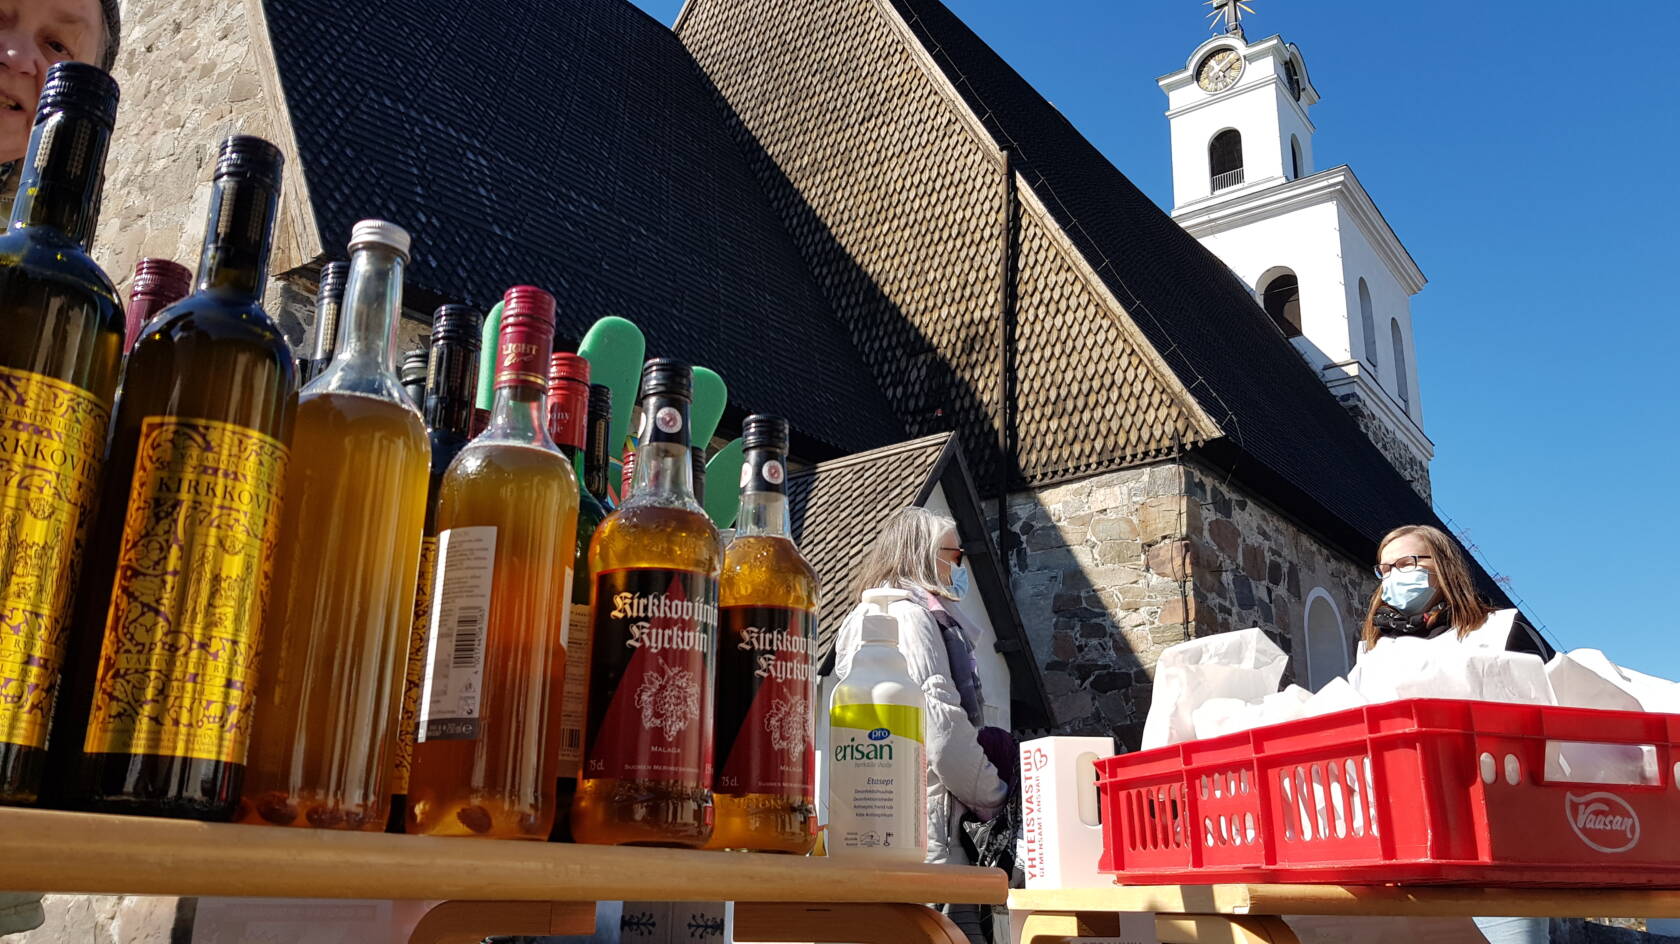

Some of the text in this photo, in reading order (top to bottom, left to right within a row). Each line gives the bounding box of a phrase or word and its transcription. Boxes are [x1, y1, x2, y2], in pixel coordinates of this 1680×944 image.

[502, 343, 539, 356] LIGHT
[625, 621, 708, 653] Kyrkvin
[871, 728, 889, 740] pro
[835, 736, 893, 762] erisan
[866, 776, 894, 786] Etasept
[1023, 749, 1037, 881] YHTEISVASTUU
[1576, 802, 1633, 839] Vaasan
